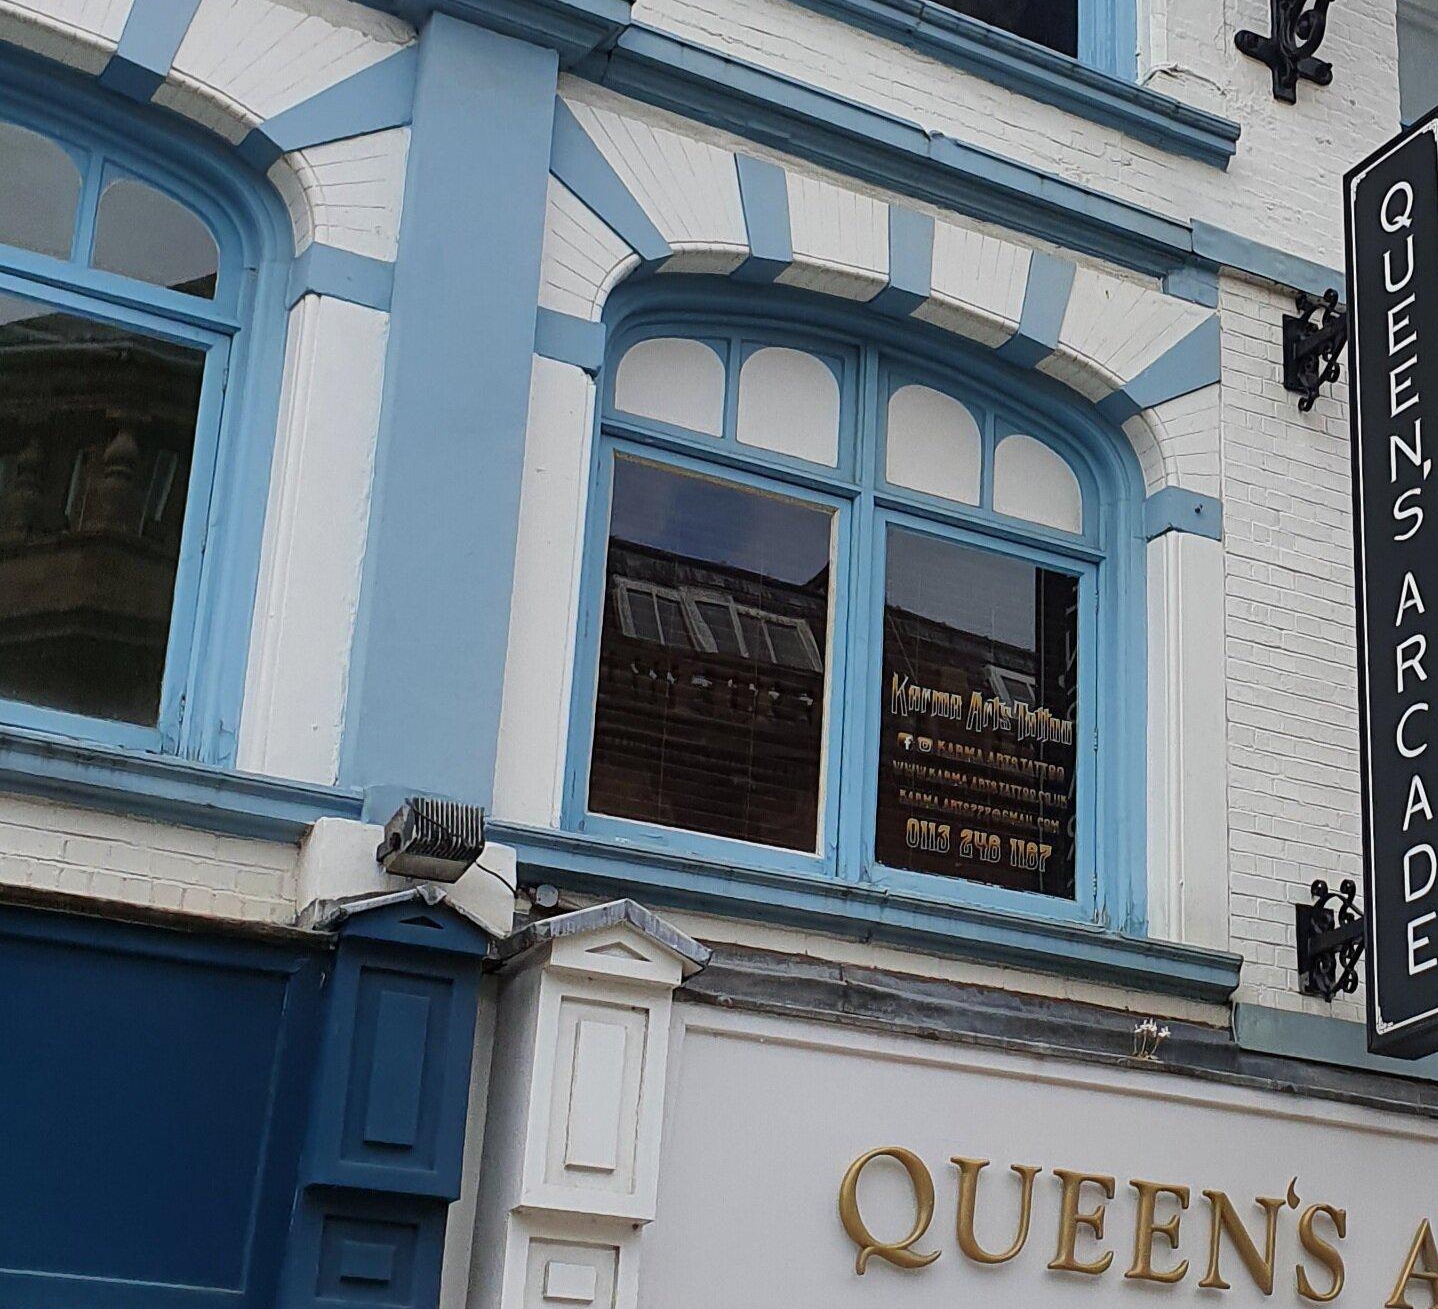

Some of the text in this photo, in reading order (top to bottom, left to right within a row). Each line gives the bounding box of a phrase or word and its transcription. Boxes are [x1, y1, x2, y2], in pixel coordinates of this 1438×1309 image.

[891, 671, 1073, 746] Karma Arts Tattoo
[1394, 570, 1438, 976] ARCADE
[906, 817, 951, 854] 0113
[838, 1145, 1348, 1305] QUEEN'S
